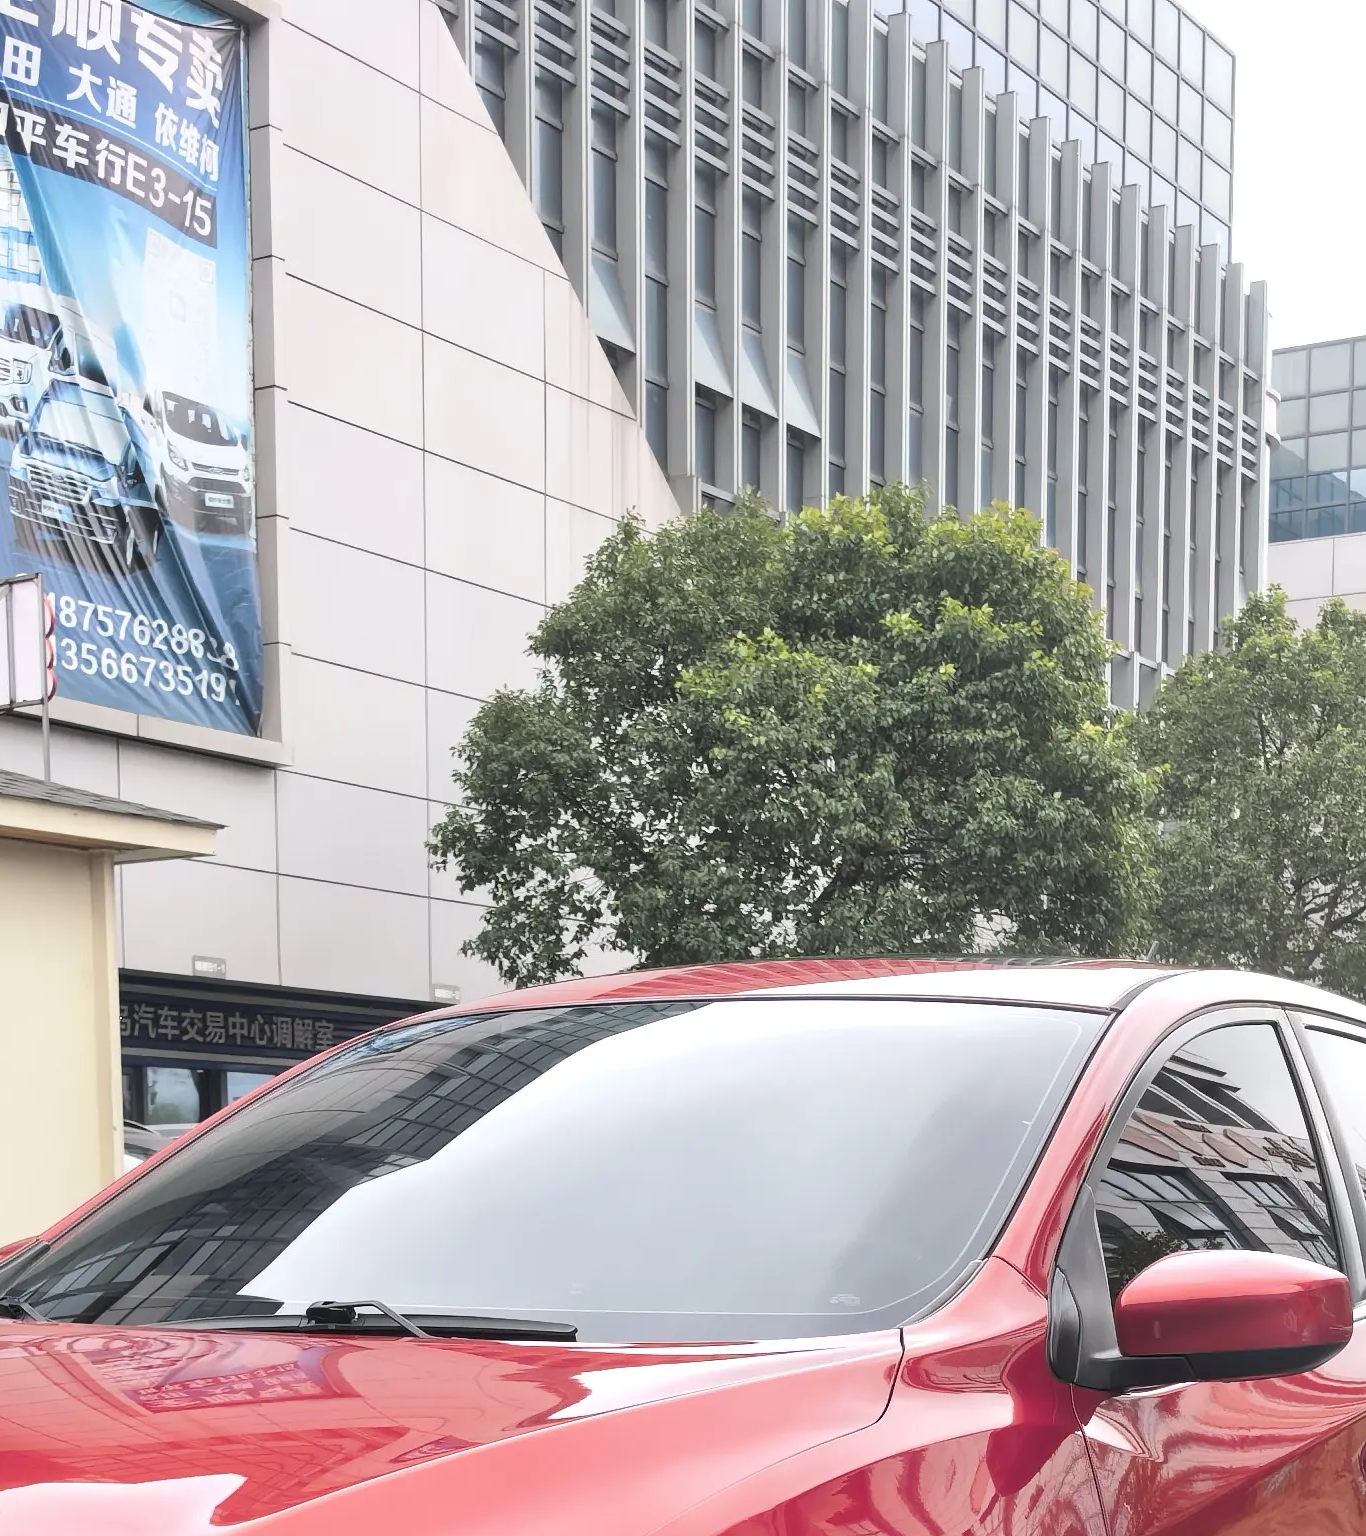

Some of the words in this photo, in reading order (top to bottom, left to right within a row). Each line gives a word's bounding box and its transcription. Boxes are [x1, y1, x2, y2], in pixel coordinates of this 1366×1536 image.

[66, 63, 137, 129] 大通
[155, 102, 219, 182] 依维柯
